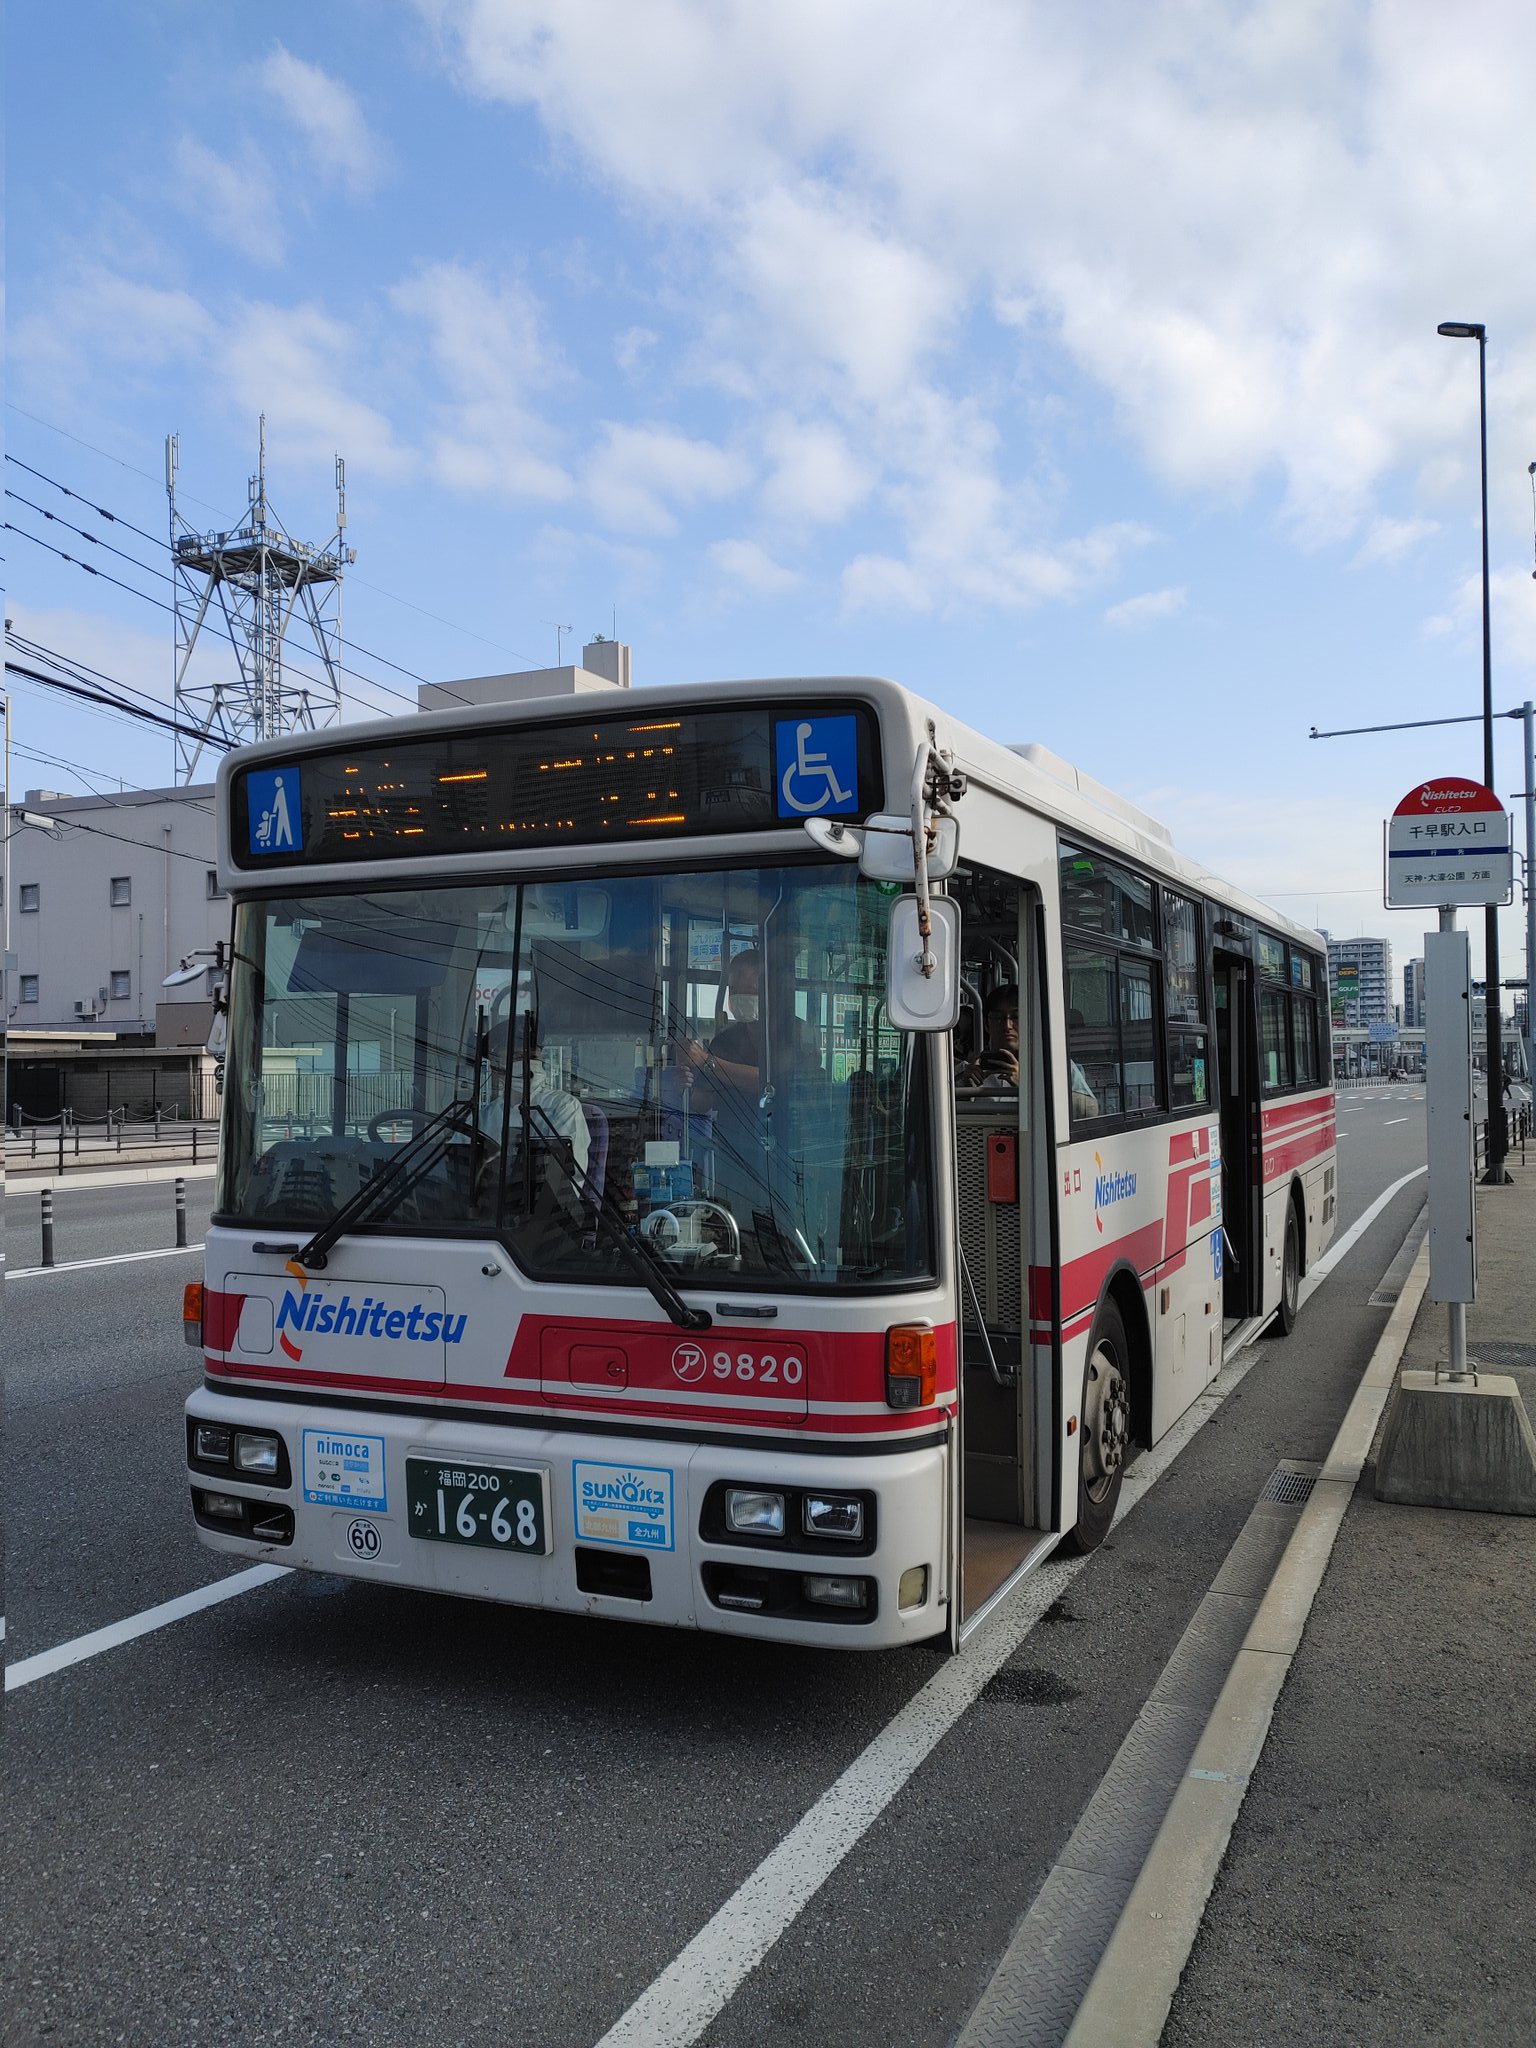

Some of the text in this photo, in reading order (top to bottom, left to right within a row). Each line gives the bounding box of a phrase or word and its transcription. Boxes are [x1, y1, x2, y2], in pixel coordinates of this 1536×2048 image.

[1420, 789, 1477, 802] Nishitetsu
[1409, 821, 1486, 839] 千早駅入口
[1472, 870, 1491, 880] 方面
[1064, 1168, 1082, 1197] 出口
[1094, 1171, 1137, 1210] Nishitetsu
[275, 1289, 468, 1344] Nishitetsu
[712, 1351, 803, 1385] 9820
[316, 1436, 369, 1459] nimoca
[414, 1489, 537, 1546] か 16-68
[352, 1528, 378, 1551] 60
[634, 1526, 660, 1540] 全九州
